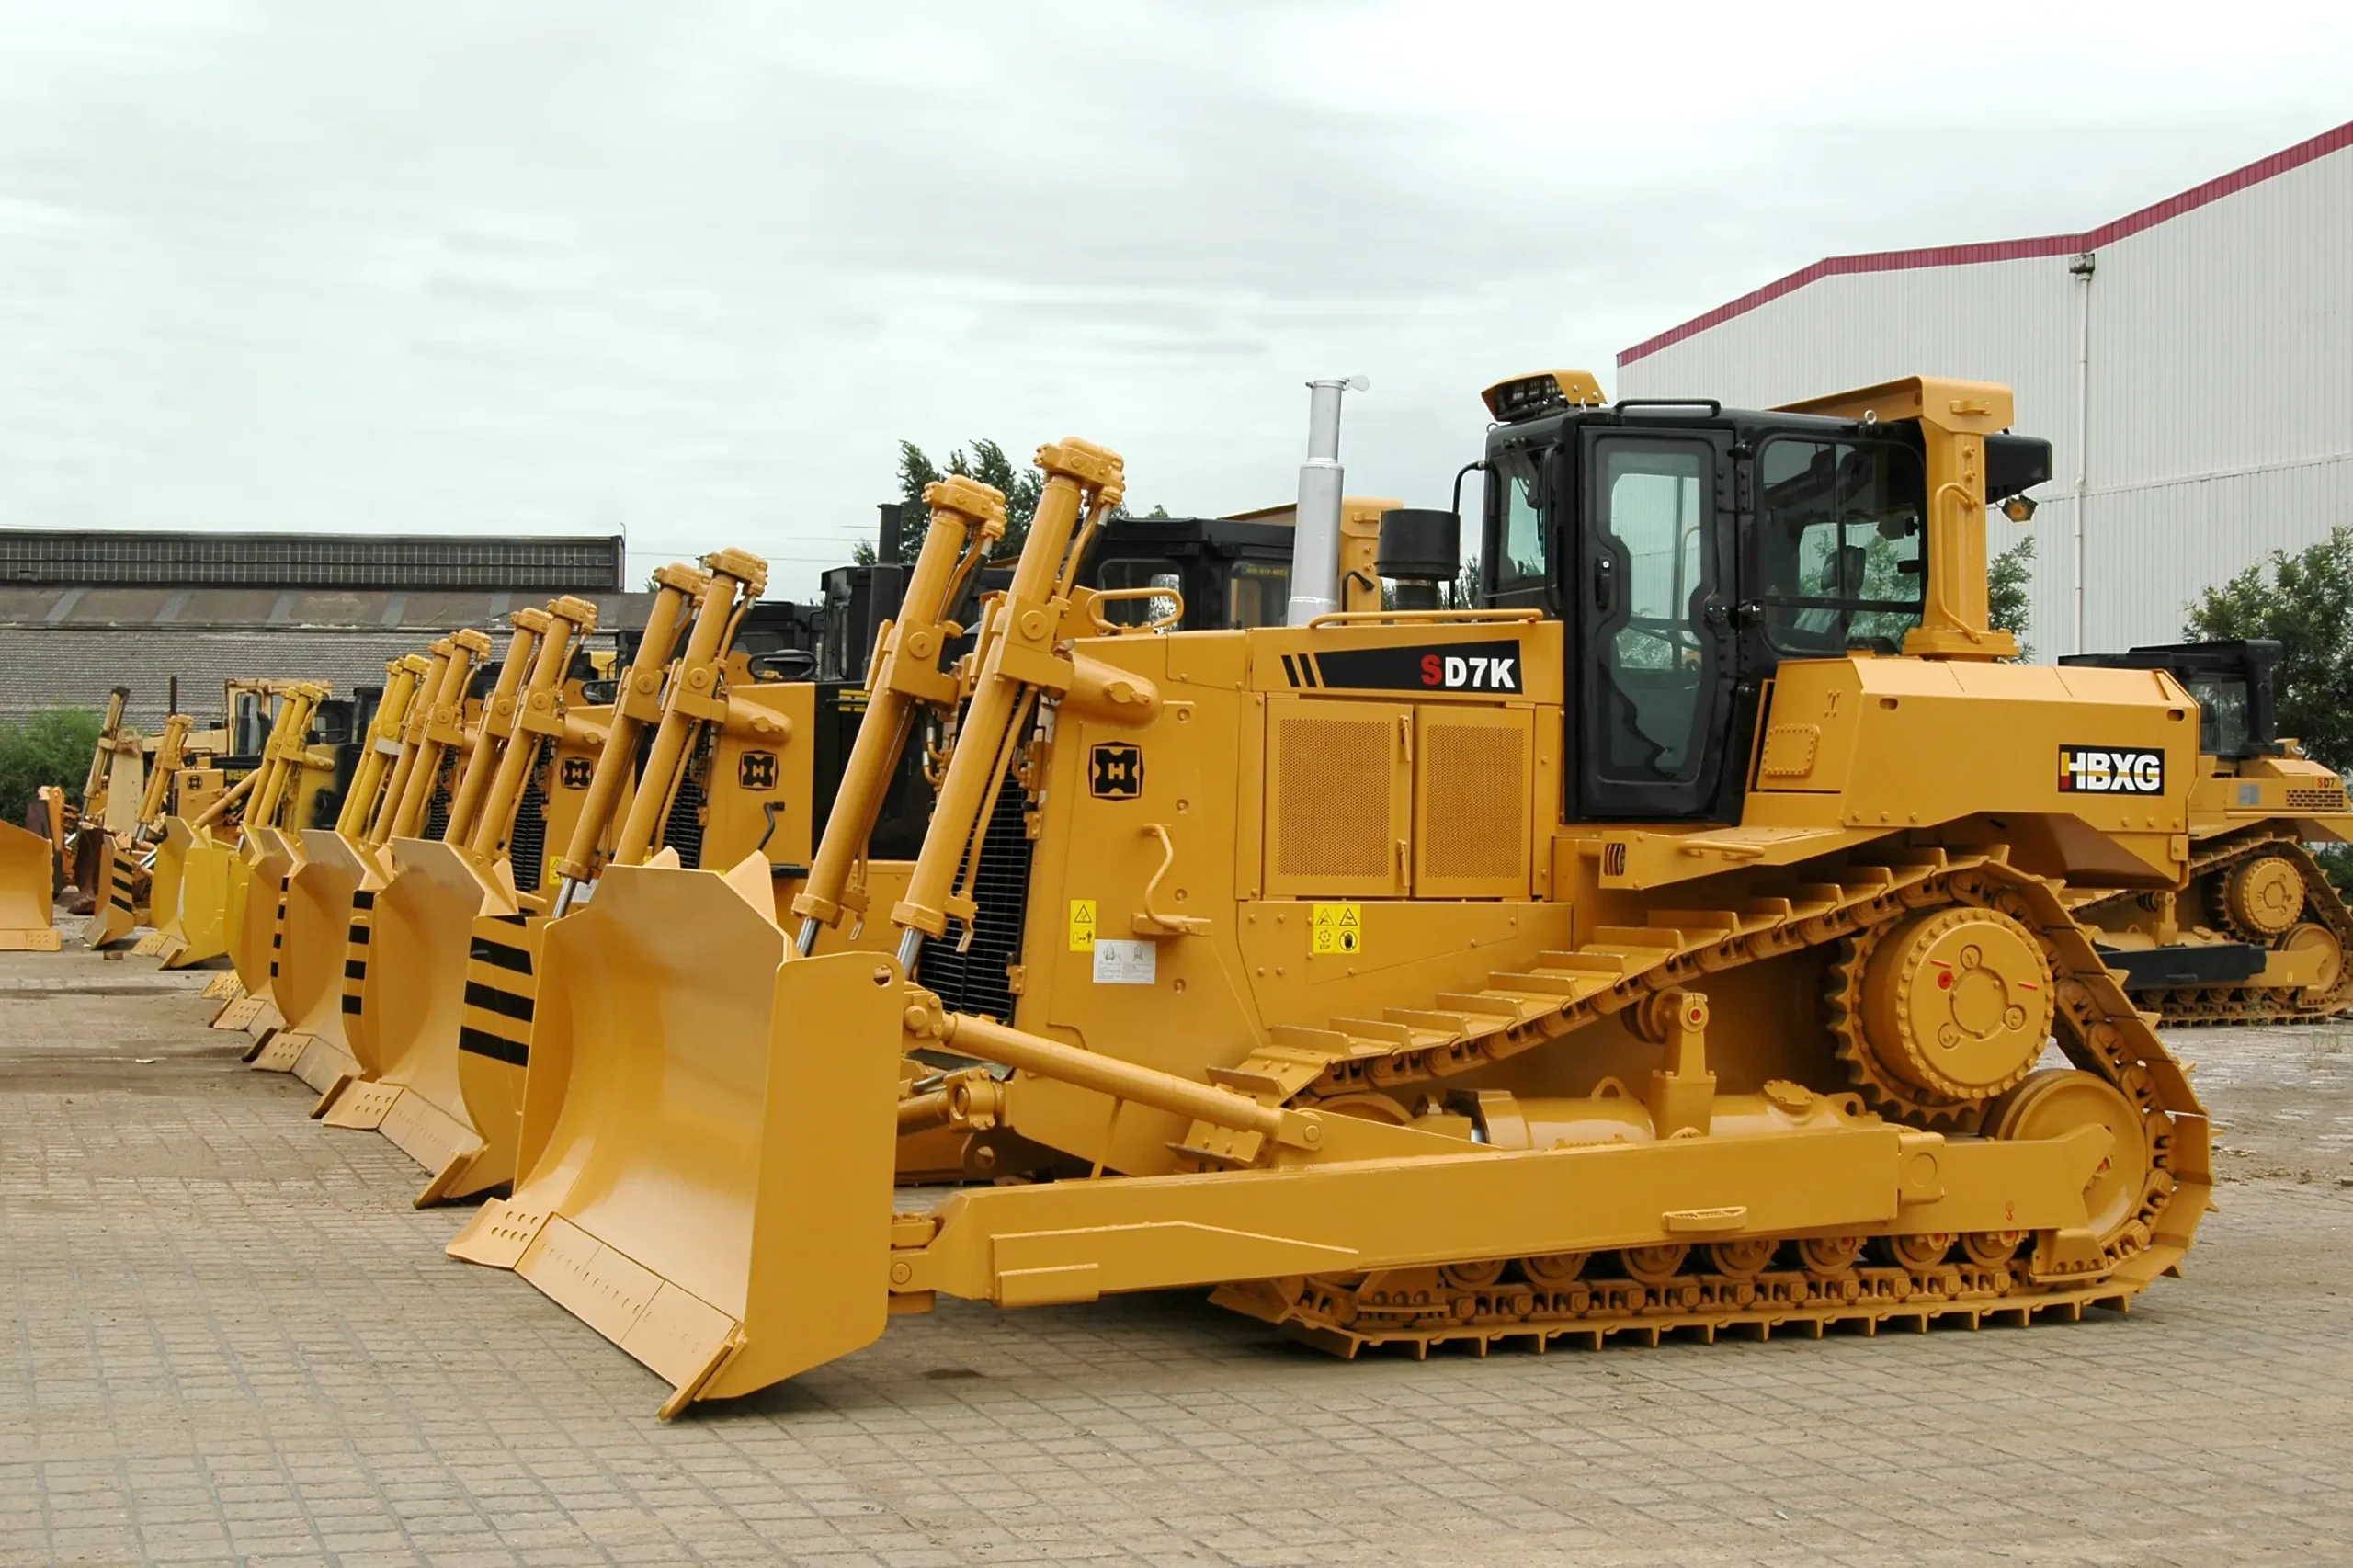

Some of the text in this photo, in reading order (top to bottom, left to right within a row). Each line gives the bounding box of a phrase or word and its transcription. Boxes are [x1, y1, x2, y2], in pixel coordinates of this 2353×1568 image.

[1421, 654, 1515, 688] SD7K
[2061, 752, 2160, 791] HBXG
[2317, 777, 2336, 789] SD7
